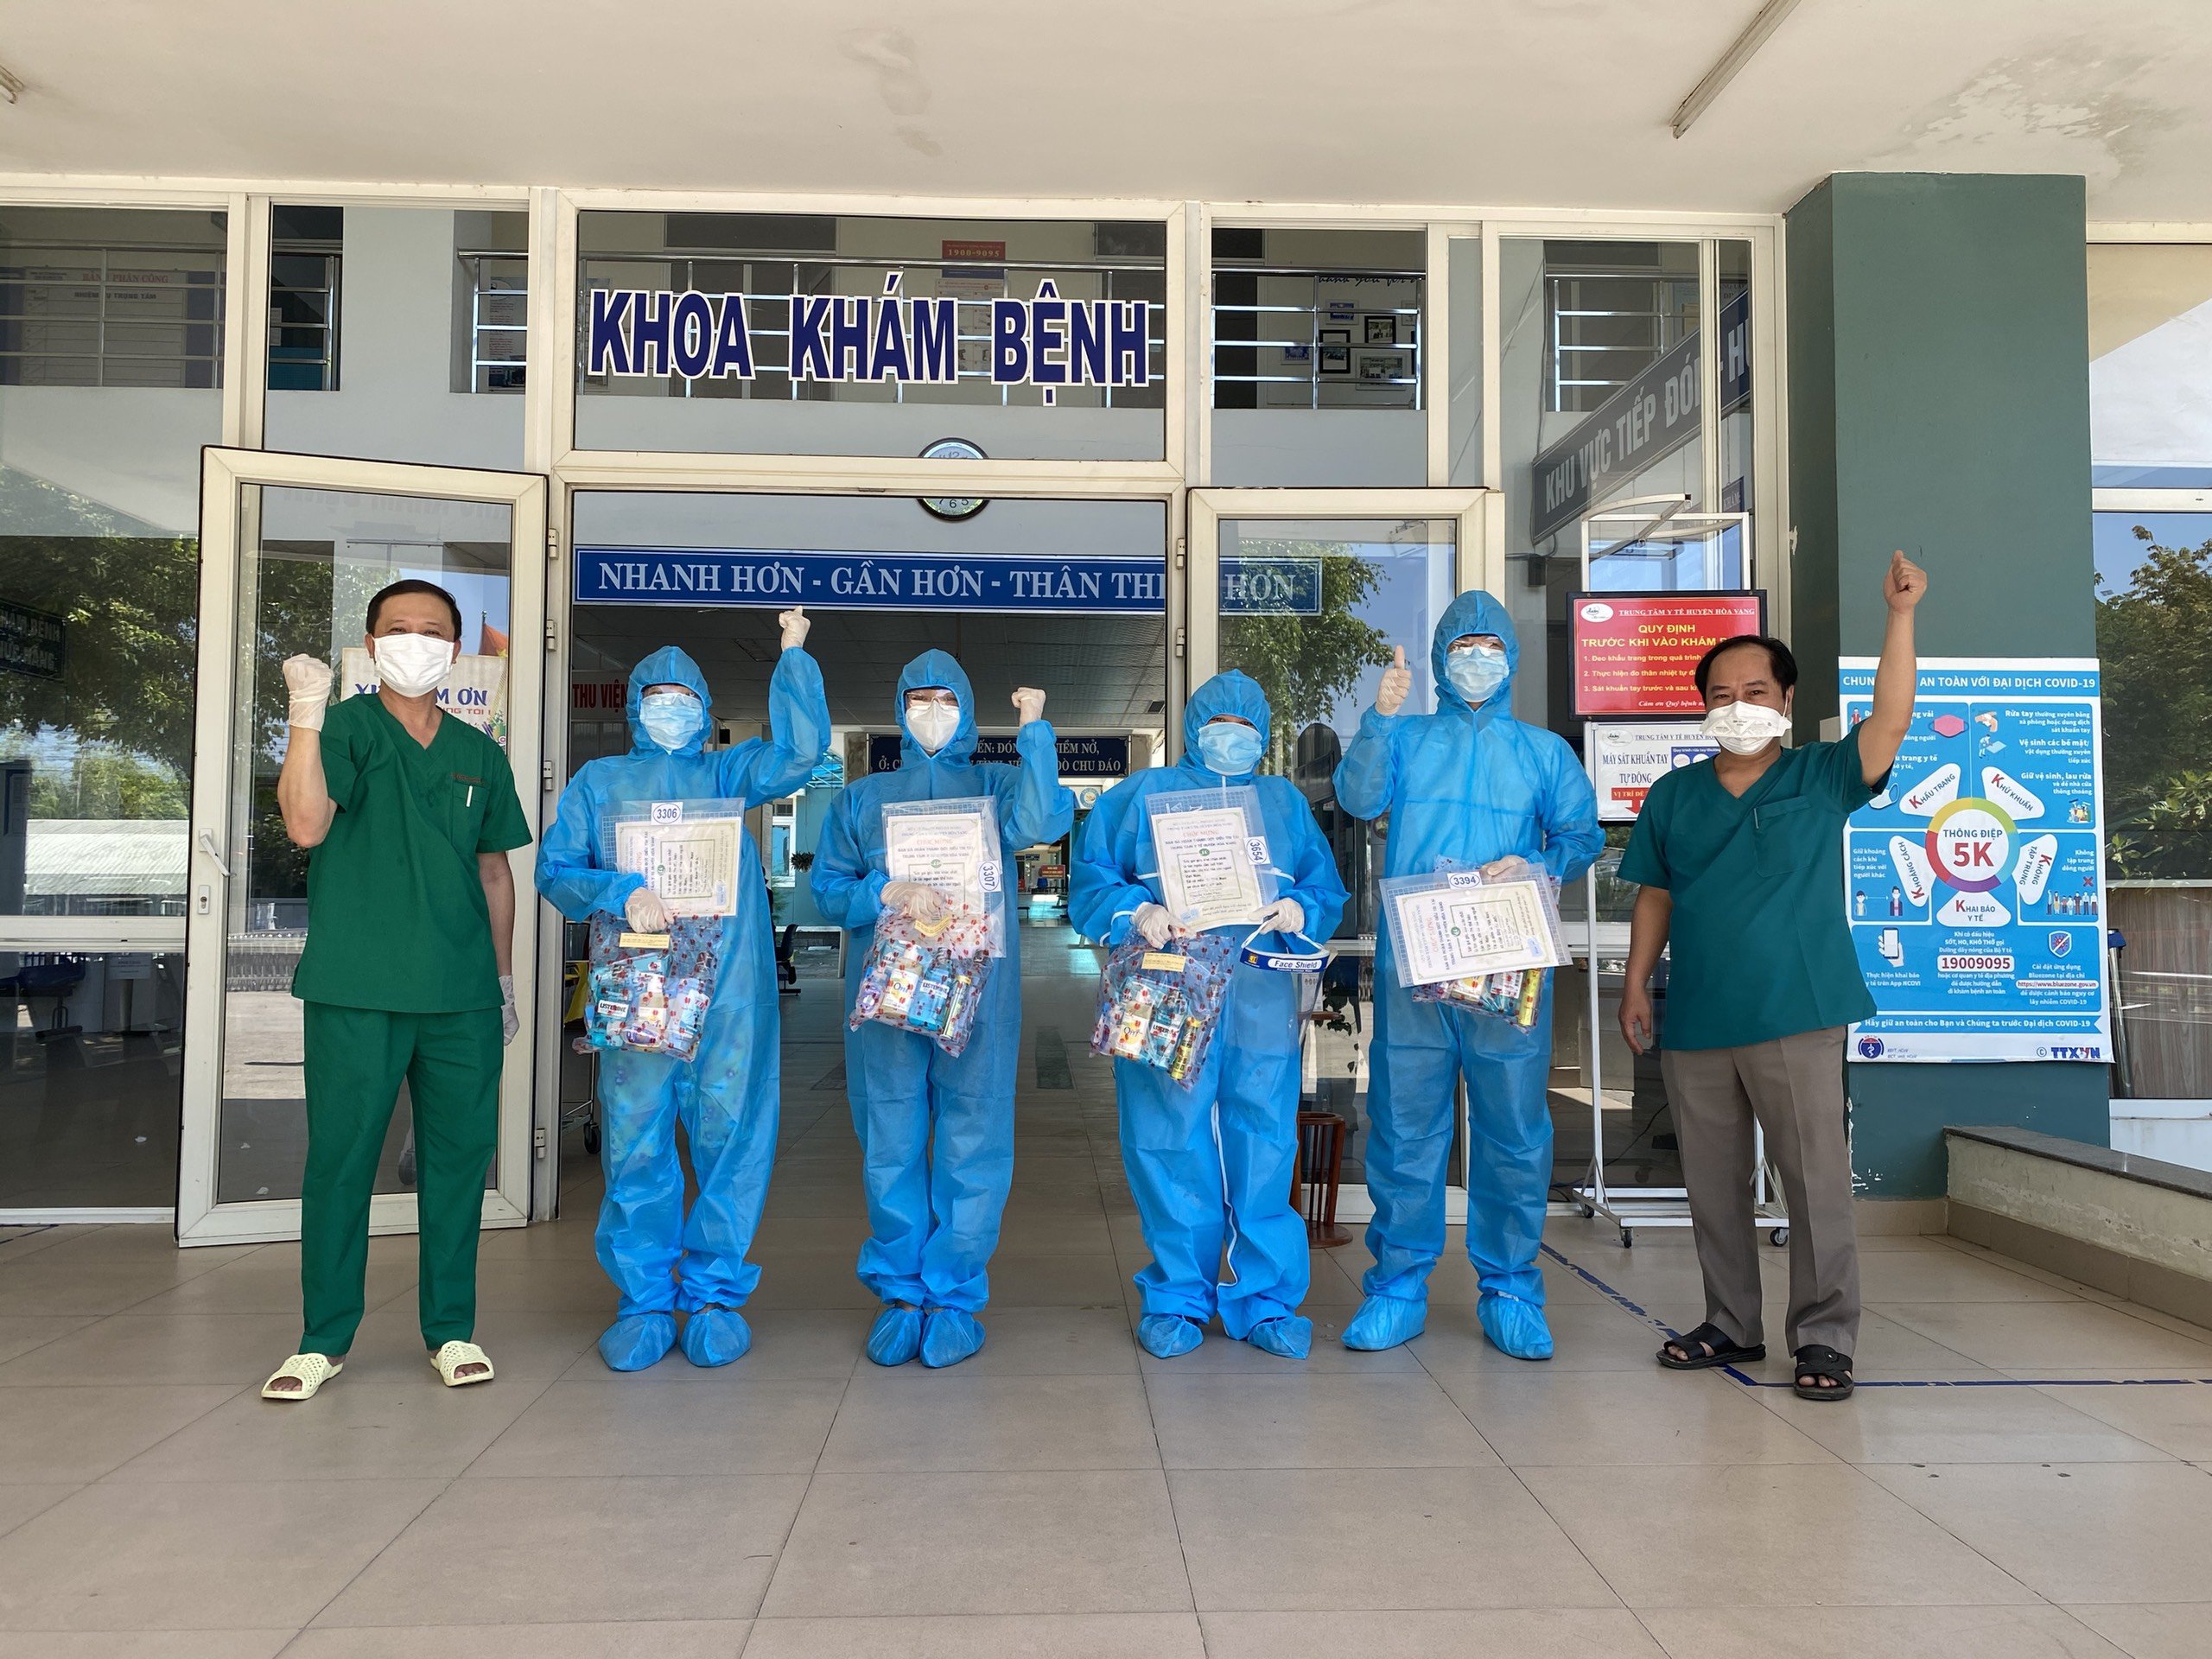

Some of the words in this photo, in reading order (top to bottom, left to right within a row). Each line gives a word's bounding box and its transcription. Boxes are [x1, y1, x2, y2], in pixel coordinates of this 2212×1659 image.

[949, 249, 1000, 257] 1900-9095
[587, 289, 755, 379] KHOA
[789, 271, 958, 385] KHÁM
[991, 278, 1149, 406] BỆNH
[1546, 454, 1575, 514] KHU
[1579, 429, 1611, 490] VỰC
[1616, 386, 1656, 462] TIẾP
[949, 499, 957, 508] 6
[599, 563, 721, 593] NHANH
[731, 561, 804, 594] HƠN
[831, 560, 900, 596] GẦN
[912, 564, 983, 597] HƠN
[1009, 565, 1102, 599] THÂN
[1111, 573, 1165, 600] THI
[1224, 572, 1296, 601] HƠN
[1638, 624, 1664, 634] QUY
[1667, 624, 1695, 635] ĐỊNH
[1581, 637, 1625, 647] TRƯỚC
[1629, 638, 1649, 646] KHI
[1652, 636, 1678, 646] VÀO
[1681, 636, 1716, 646] KHÁM
[1649, 655, 1668, 664] trong
[1659, 669, 1678, 677] nhiệt
[1843, 676, 1875, 686] CHUN
[1920, 677, 1936, 687] AN
[1937, 676, 1968, 688] TOÀN
[1971, 676, 1990, 688] VỚI
[1993, 677, 2012, 690] ĐẠI
[2015, 677, 2042, 690] DỊCH
[2044, 678, 2096, 688] COVID-19
[457, 687, 487, 706] ƠN
[572, 683, 597, 709] THU
[600, 679, 629, 713] VIỆN
[977, 740, 994, 753] ẾN:
[1080, 738, 1100, 755] NỞ,
[1602, 753, 1616, 764] MÁY
[1618, 753, 1631, 764] SÁT
[1631, 751, 1656, 764] KHUẨN
[1656, 753, 1668, 764] TAY
[1073, 760, 1096, 772] CHU
[1098, 759, 1122, 772] ĐÁO
[1619, 772, 1630, 786] TỰ
[1631, 771, 1652, 786] ĐỘNG
[2036, 772, 2044, 781] vệ
[1909, 790, 1935, 809] KHẨU
[1934, 773, 1956, 792] TRANG
[1991, 773, 2011, 795] KHỬ
[2010, 791, 2034, 811] KHUẨN
[657, 809, 677, 819] 3306
[1943, 828, 1977, 838] THÔNG
[1980, 828, 2003, 840] ĐIỆP
[1249, 841, 1263, 862] 3654
[1897, 842, 1910, 861] CÁCH
[1953, 842, 1994, 868] 5K
[2027, 845, 2037, 860] TẬP
[983, 861, 995, 888] 3307
[2018, 861, 2032, 885] TRUNG
[2032, 854, 2052, 885] KHÔNG
[1453, 876, 1476, 886] 3394
[1906, 861, 1925, 899] KHOẢNG
[1956, 900, 1979, 912] KHAI
[1942, 957, 2010, 969] 19009095
[1865, 1020, 1878, 1028] Hãy
[1882, 1020, 1894, 1028] giữ
[1940, 1020, 1955, 1028] Bạn
[1967, 1020, 1991, 1028] Chúng
[2037, 1020, 2053, 1028] dịch
